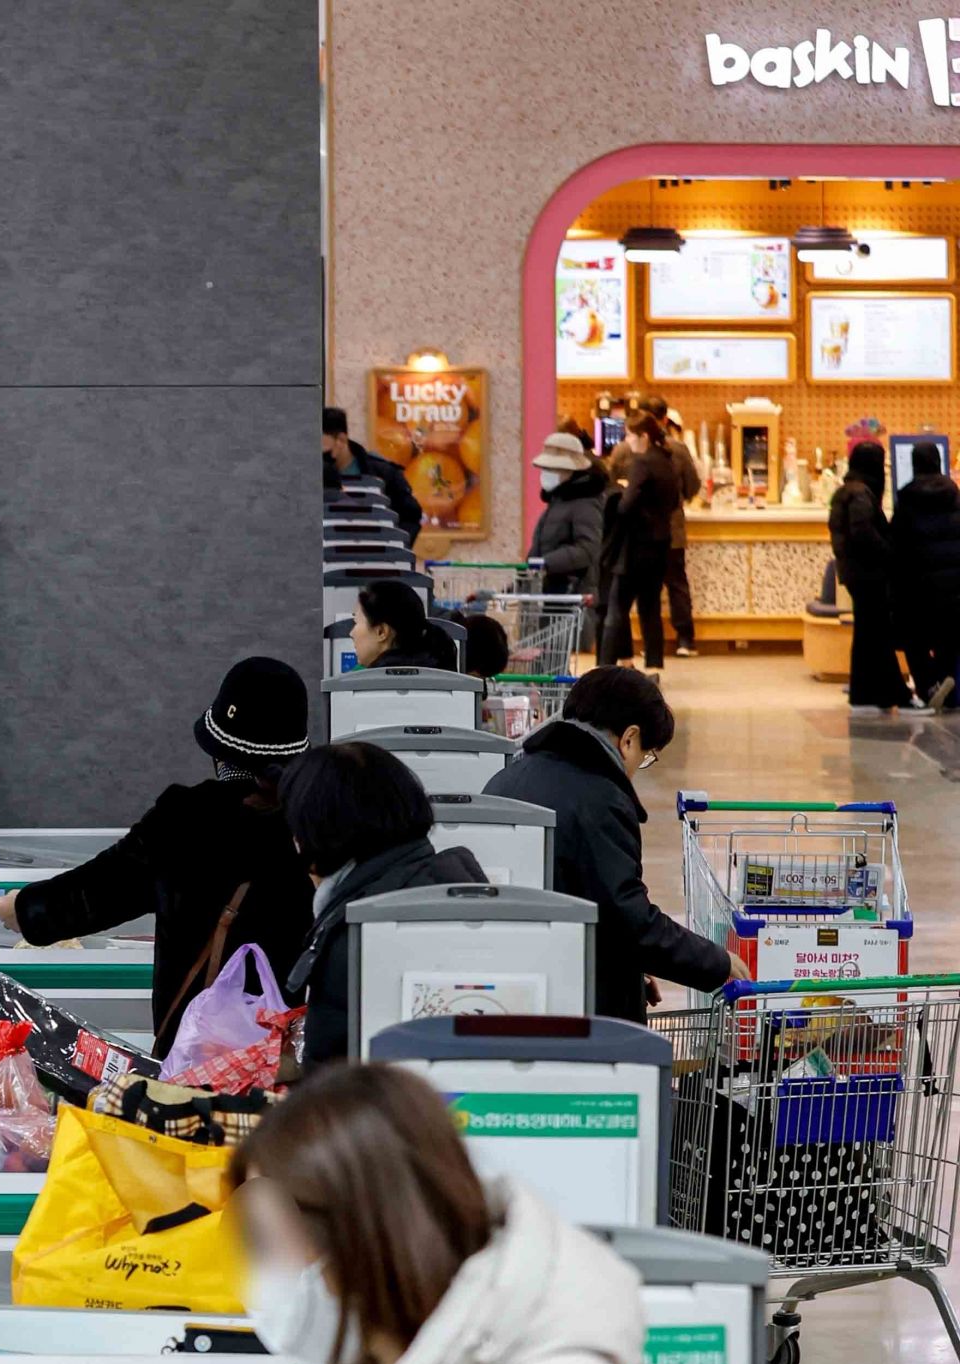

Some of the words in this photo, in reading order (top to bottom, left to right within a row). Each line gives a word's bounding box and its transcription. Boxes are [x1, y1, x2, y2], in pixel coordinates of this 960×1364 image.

[704, 28, 910, 89] baskin
[389, 380, 468, 405] Lucky
[395, 403, 462, 423] Draw
[105, 1254, 139, 1281] Why
